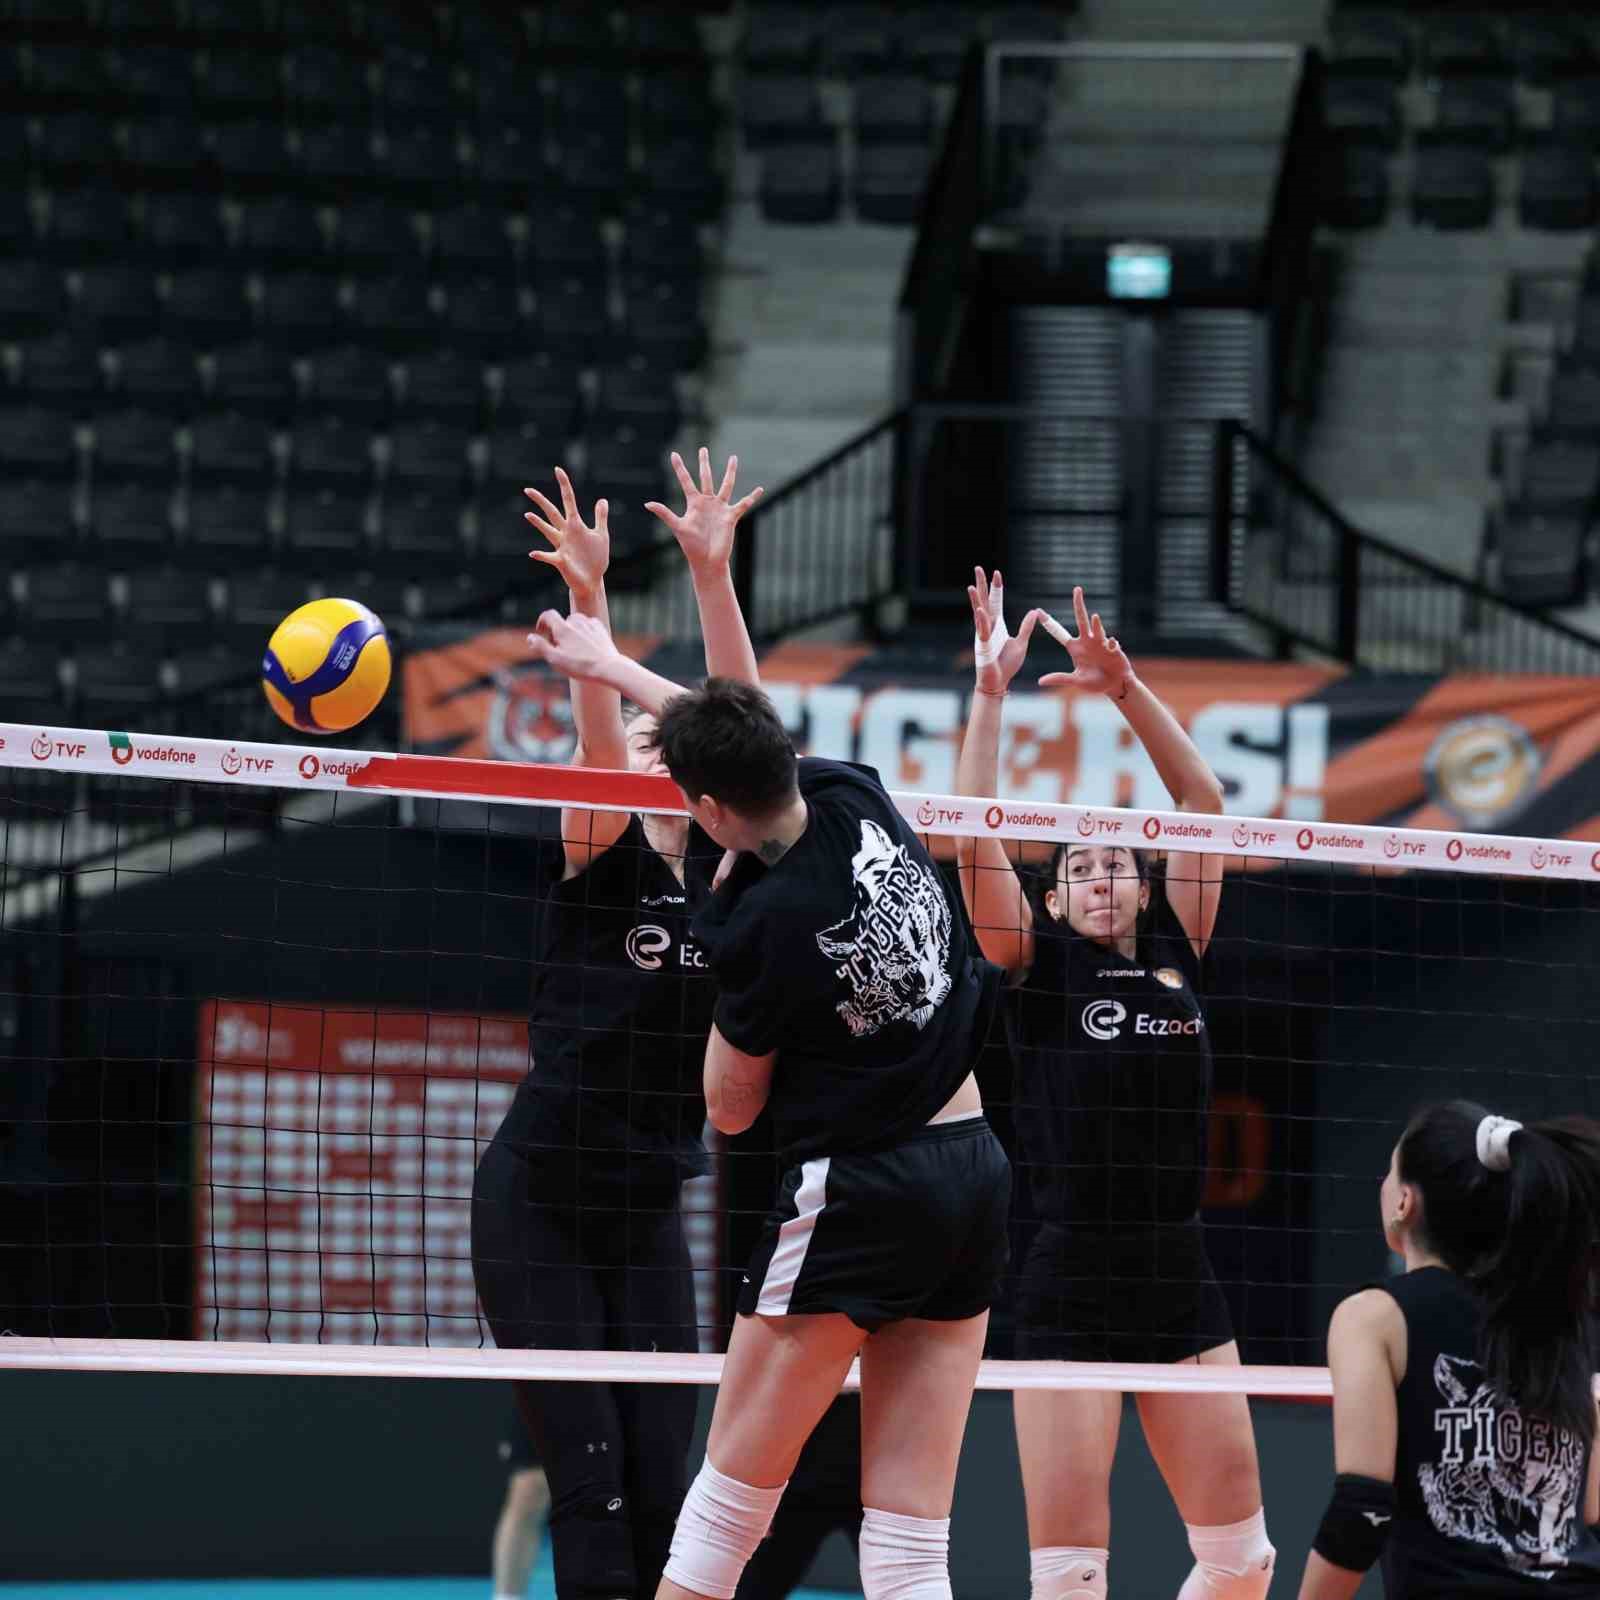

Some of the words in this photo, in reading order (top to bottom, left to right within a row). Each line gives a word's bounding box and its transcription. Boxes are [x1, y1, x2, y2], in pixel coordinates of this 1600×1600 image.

[56, 743, 86, 759] TVF
[136, 748, 196, 764] vodafone
[245, 757, 274, 774] TVF
[322, 761, 361, 776] vodaf
[762, 680, 1328, 818] IGERS!
[937, 810, 964, 825] TVF
[1006, 813, 1057, 828] vodafone
[1098, 820, 1123, 834] TVF
[1163, 823, 1213, 838] vodafone
[1252, 832, 1277, 846] TVF
[1315, 836, 1364, 850] vodafone
[1403, 842, 1427, 856] TVF
[1464, 846, 1512, 861] vodafone
[1550, 853, 1573, 867] TVF
[836, 844, 925, 994] TIGERS
[1434, 1407, 1582, 1471] TIGER
